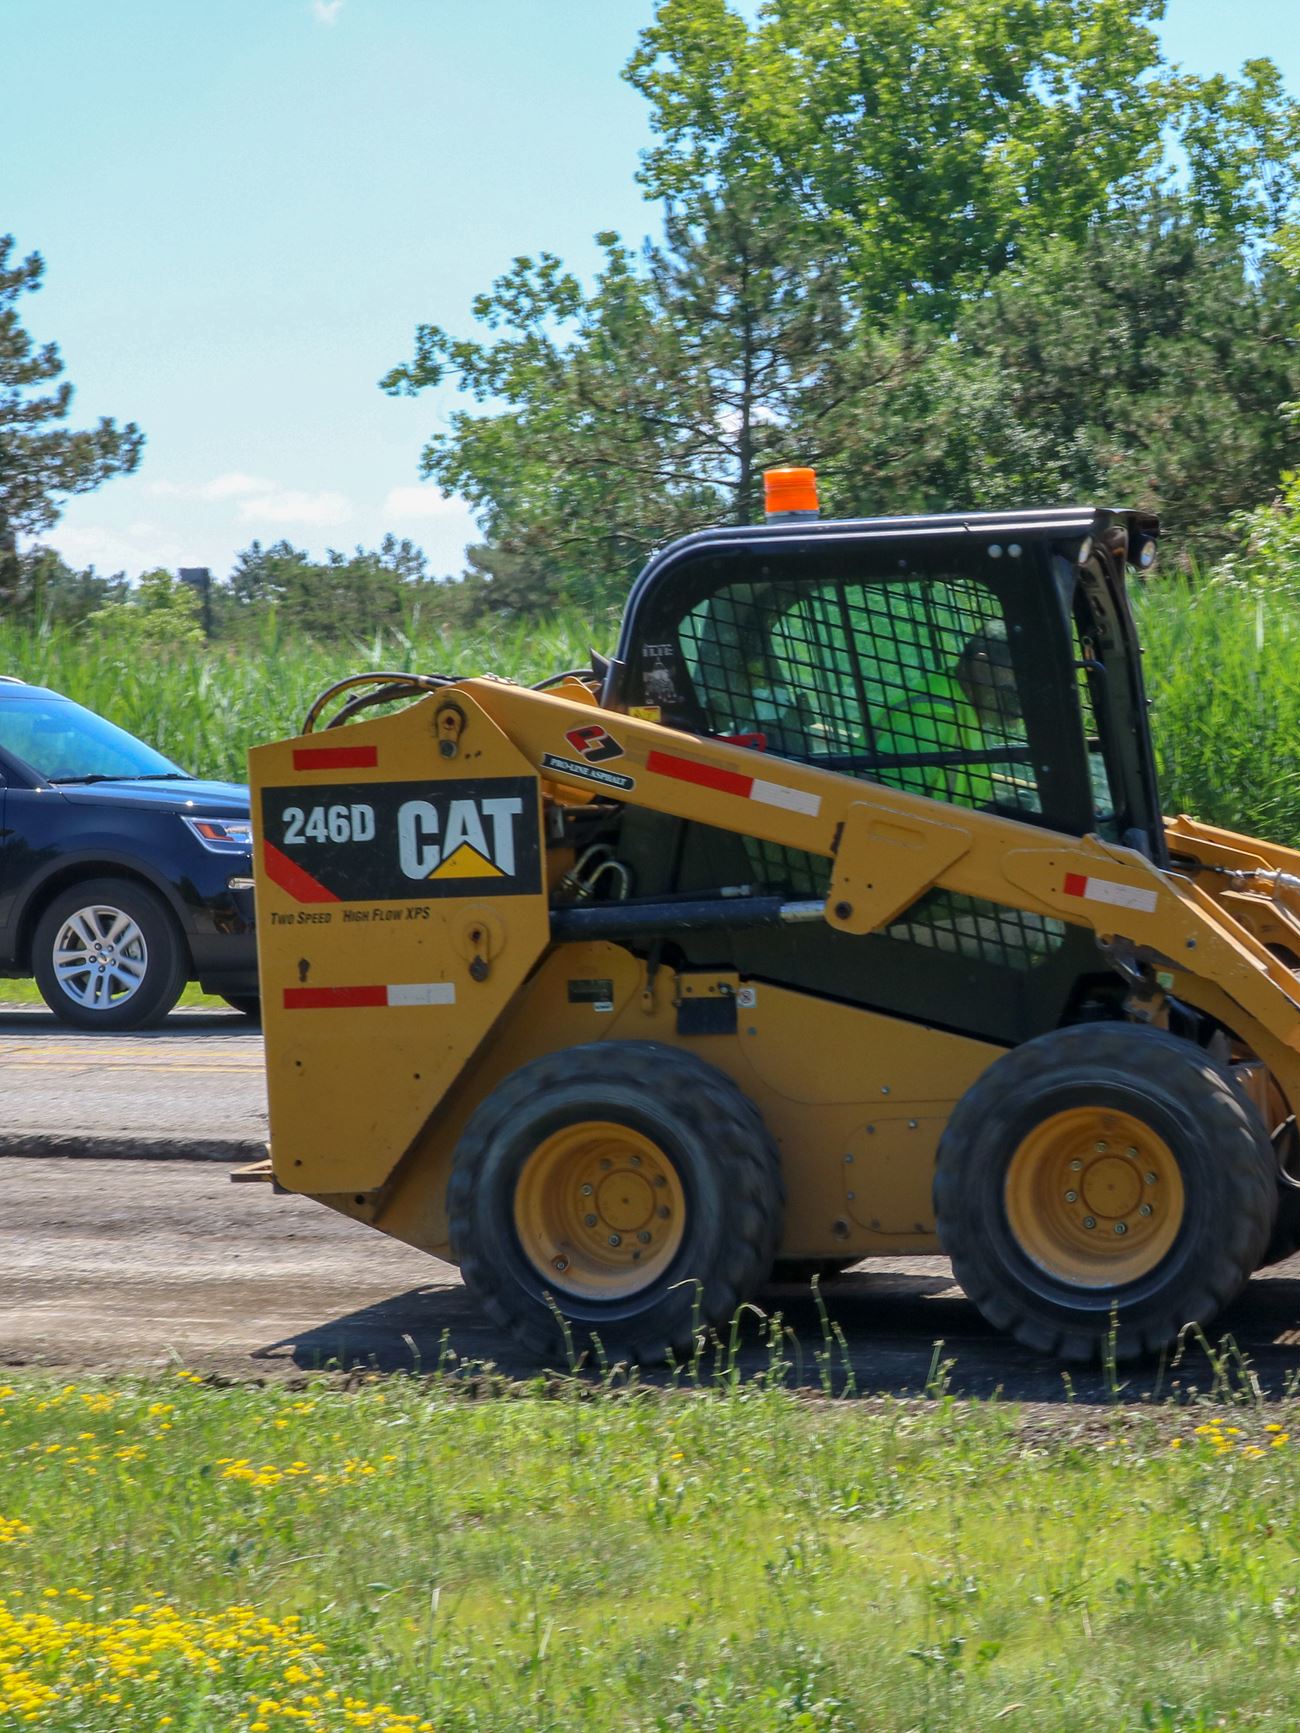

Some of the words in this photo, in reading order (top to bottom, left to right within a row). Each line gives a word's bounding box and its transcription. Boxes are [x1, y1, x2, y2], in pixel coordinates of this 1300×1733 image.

[549, 758, 589, 776] PRO-LINE
[589, 769, 628, 787] ASPHALT
[282, 804, 376, 844] 246D
[397, 797, 523, 880] CAT
[405, 906, 431, 920] XPS
